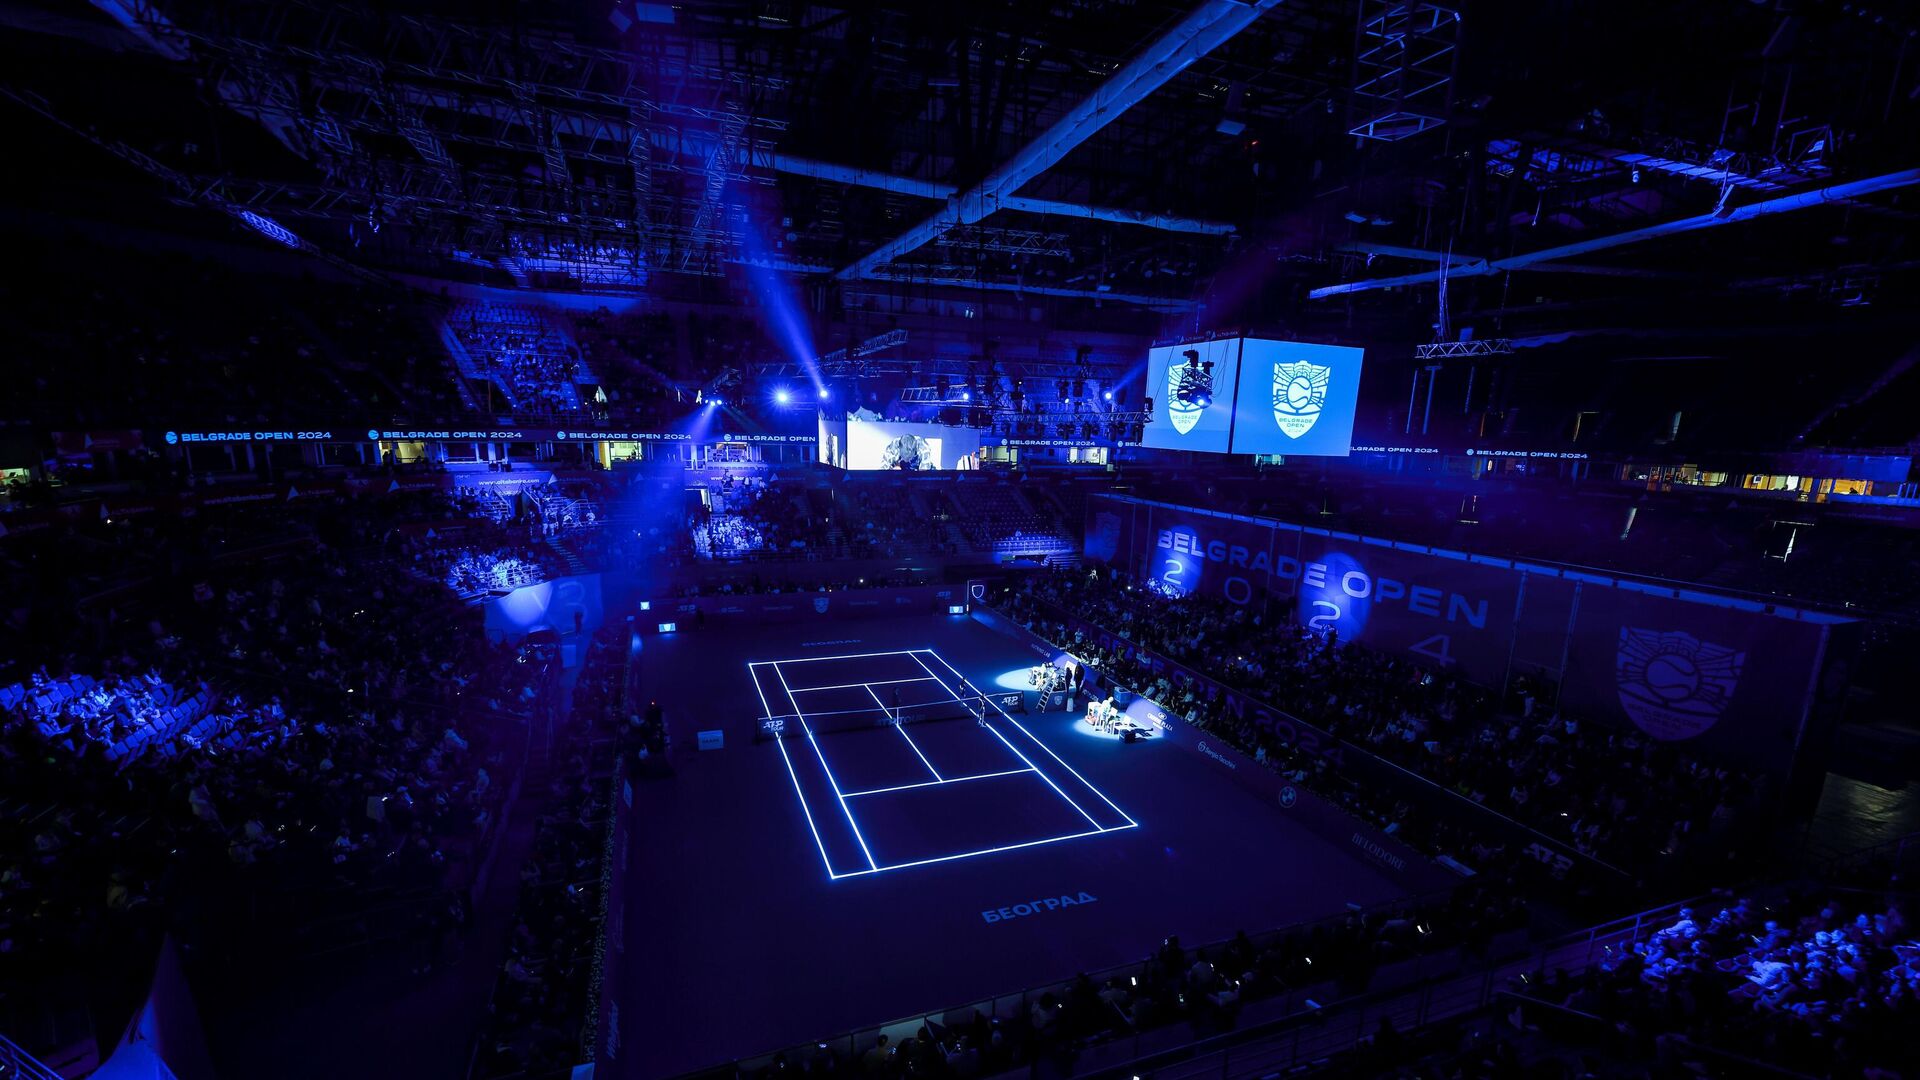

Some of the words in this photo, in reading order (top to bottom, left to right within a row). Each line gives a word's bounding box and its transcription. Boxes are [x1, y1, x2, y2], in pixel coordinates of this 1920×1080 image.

[181, 432, 251, 442] BELGRADE
[254, 431, 294, 440] OPEN
[297, 431, 333, 440] 2024
[383, 431, 450, 439] BELGRADE
[453, 431, 487, 439] OPEN
[490, 431, 523, 439] 2024
[569, 432, 629, 440] BELGRADE
[631, 432, 662, 440] OPEN
[1157, 530, 1328, 588] BELGRADE
[1341, 570, 1488, 629] OPEN
[1001, 695, 1018, 704] ATP
[763, 720, 784, 729] ATP
[1522, 842, 1574, 871] ATP
[981, 891, 1098, 924] БЕОГРАД
